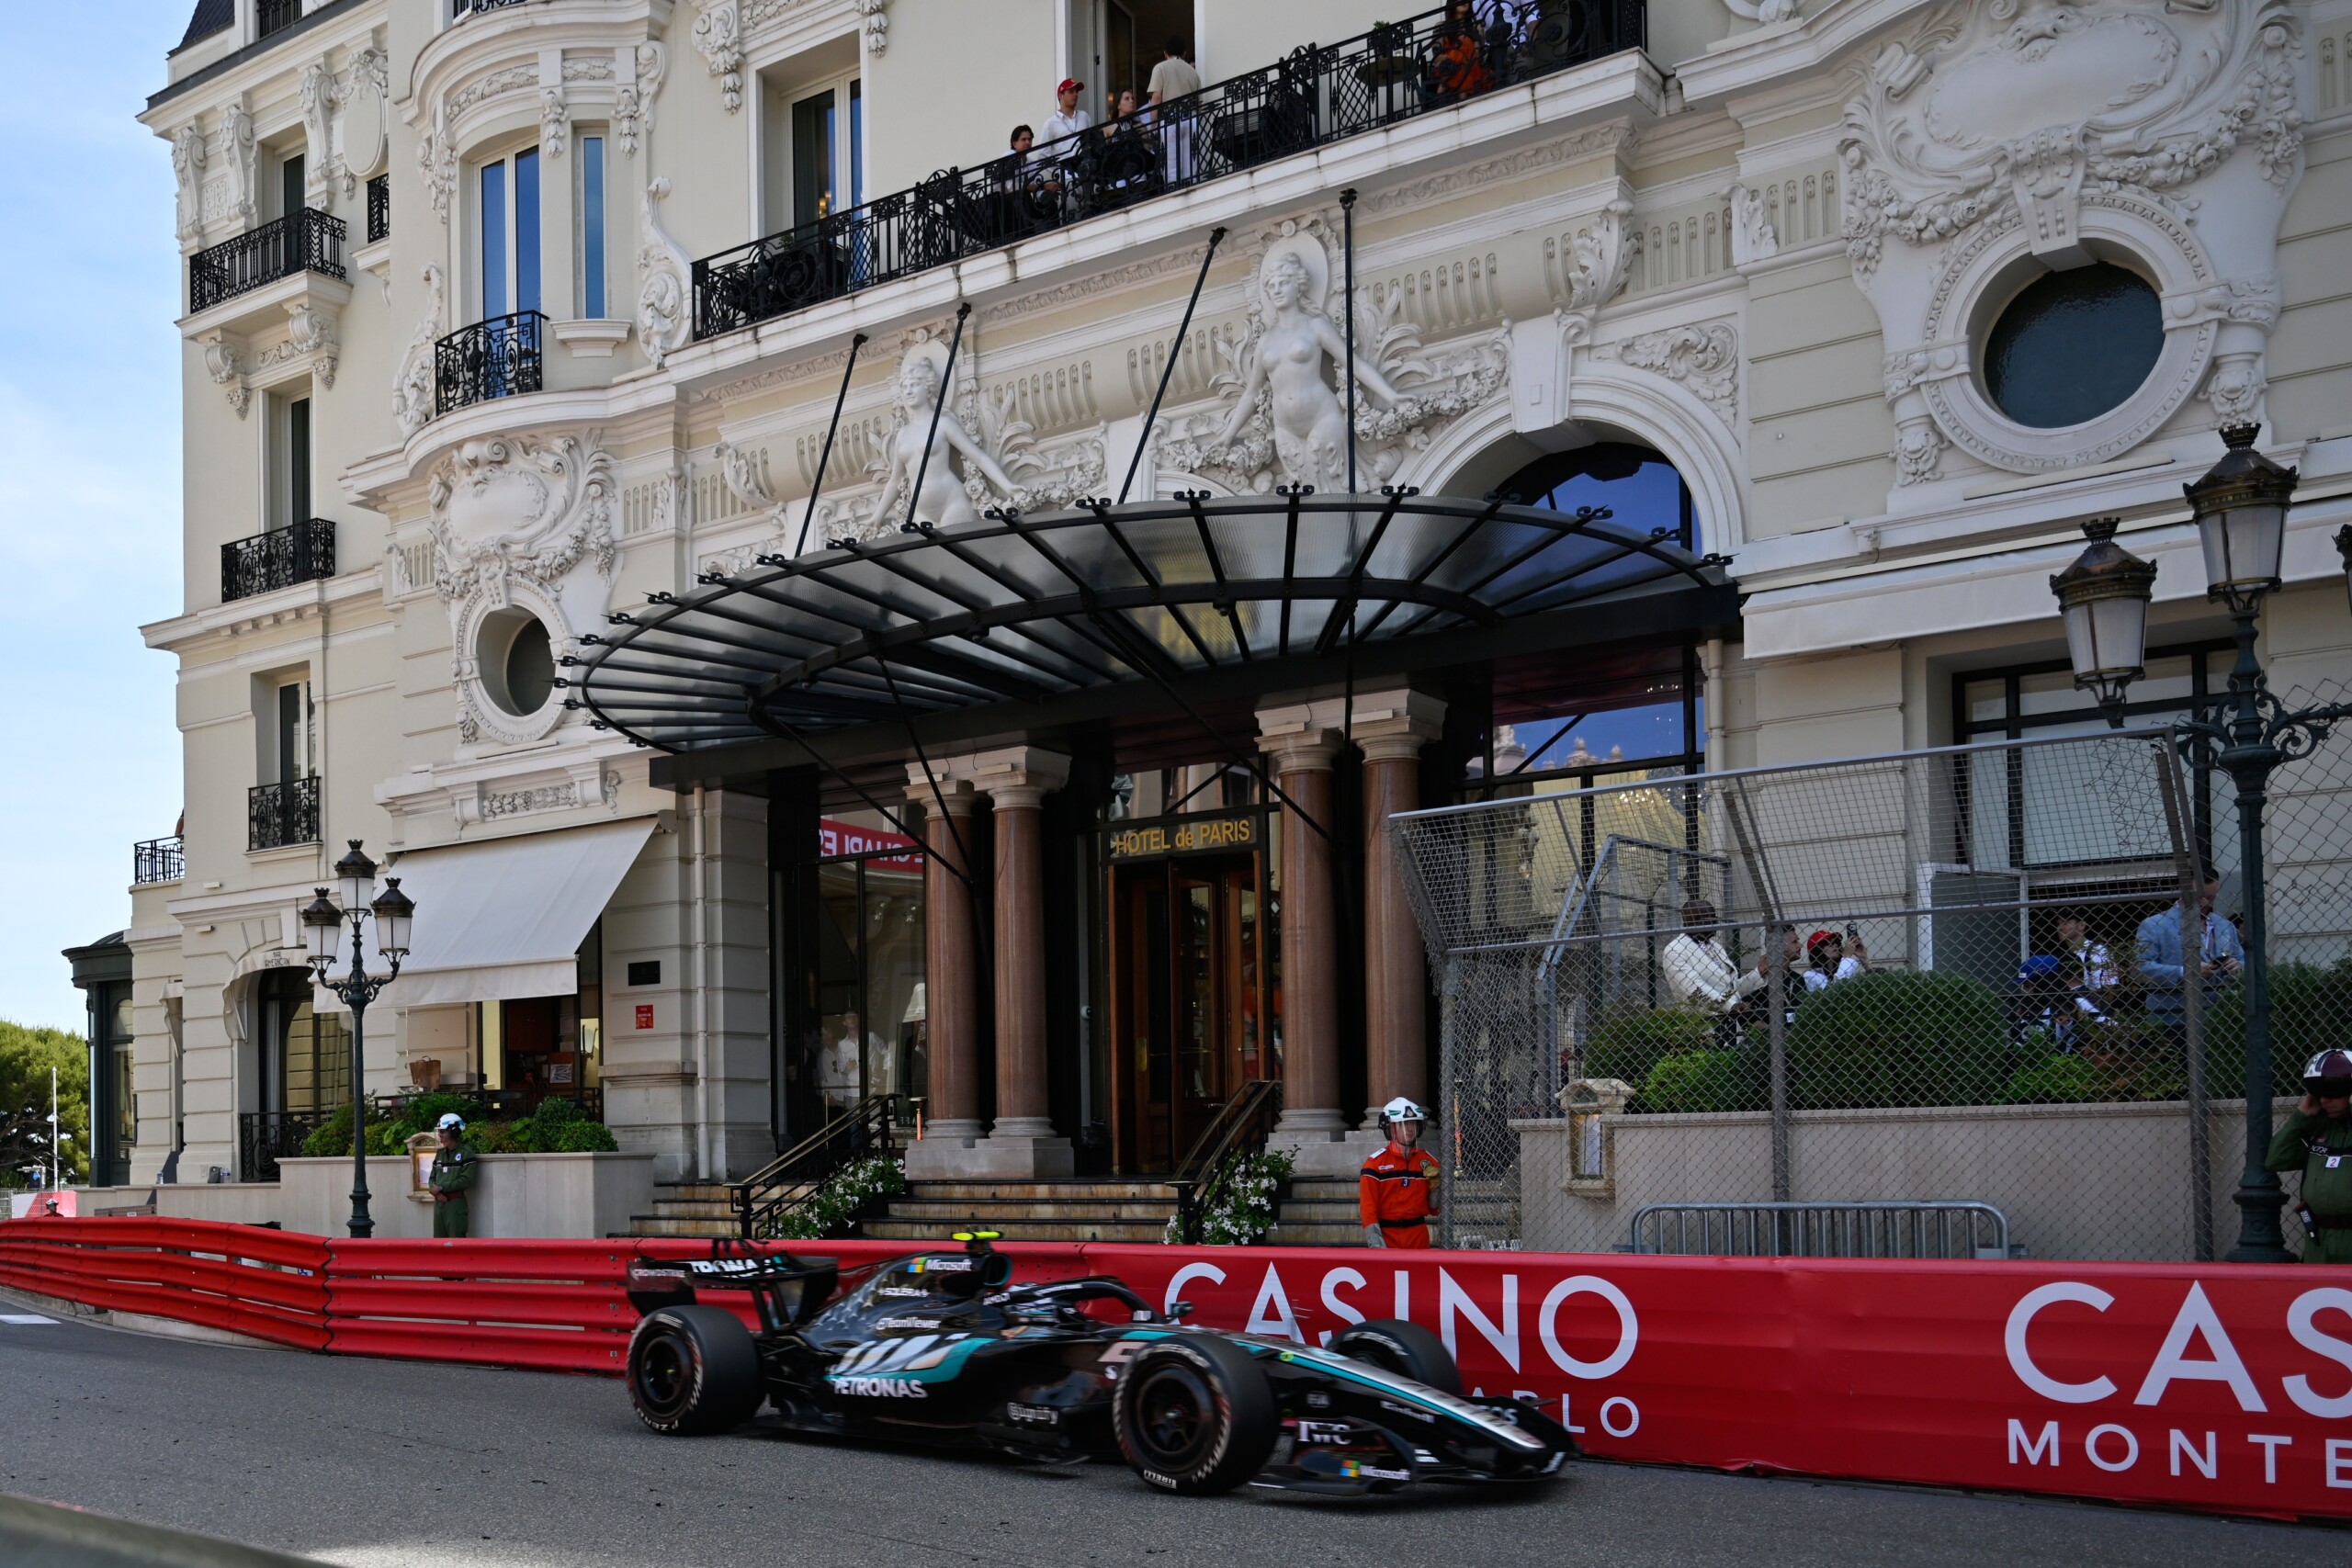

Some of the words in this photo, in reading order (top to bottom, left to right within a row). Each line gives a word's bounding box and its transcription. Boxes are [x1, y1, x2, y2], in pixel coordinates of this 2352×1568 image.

[1115, 829, 1171, 854] HOTEL
[1175, 827, 1193, 848] de
[1200, 819, 1250, 845] PARIS
[924, 1258, 972, 1271] Microsoft
[1164, 1260, 1639, 1380] CASINO
[2005, 1279, 2352, 1418] CAS
[833, 1377, 928, 1398] PETRONAS
[2007, 1418, 2352, 1489] MONTE
